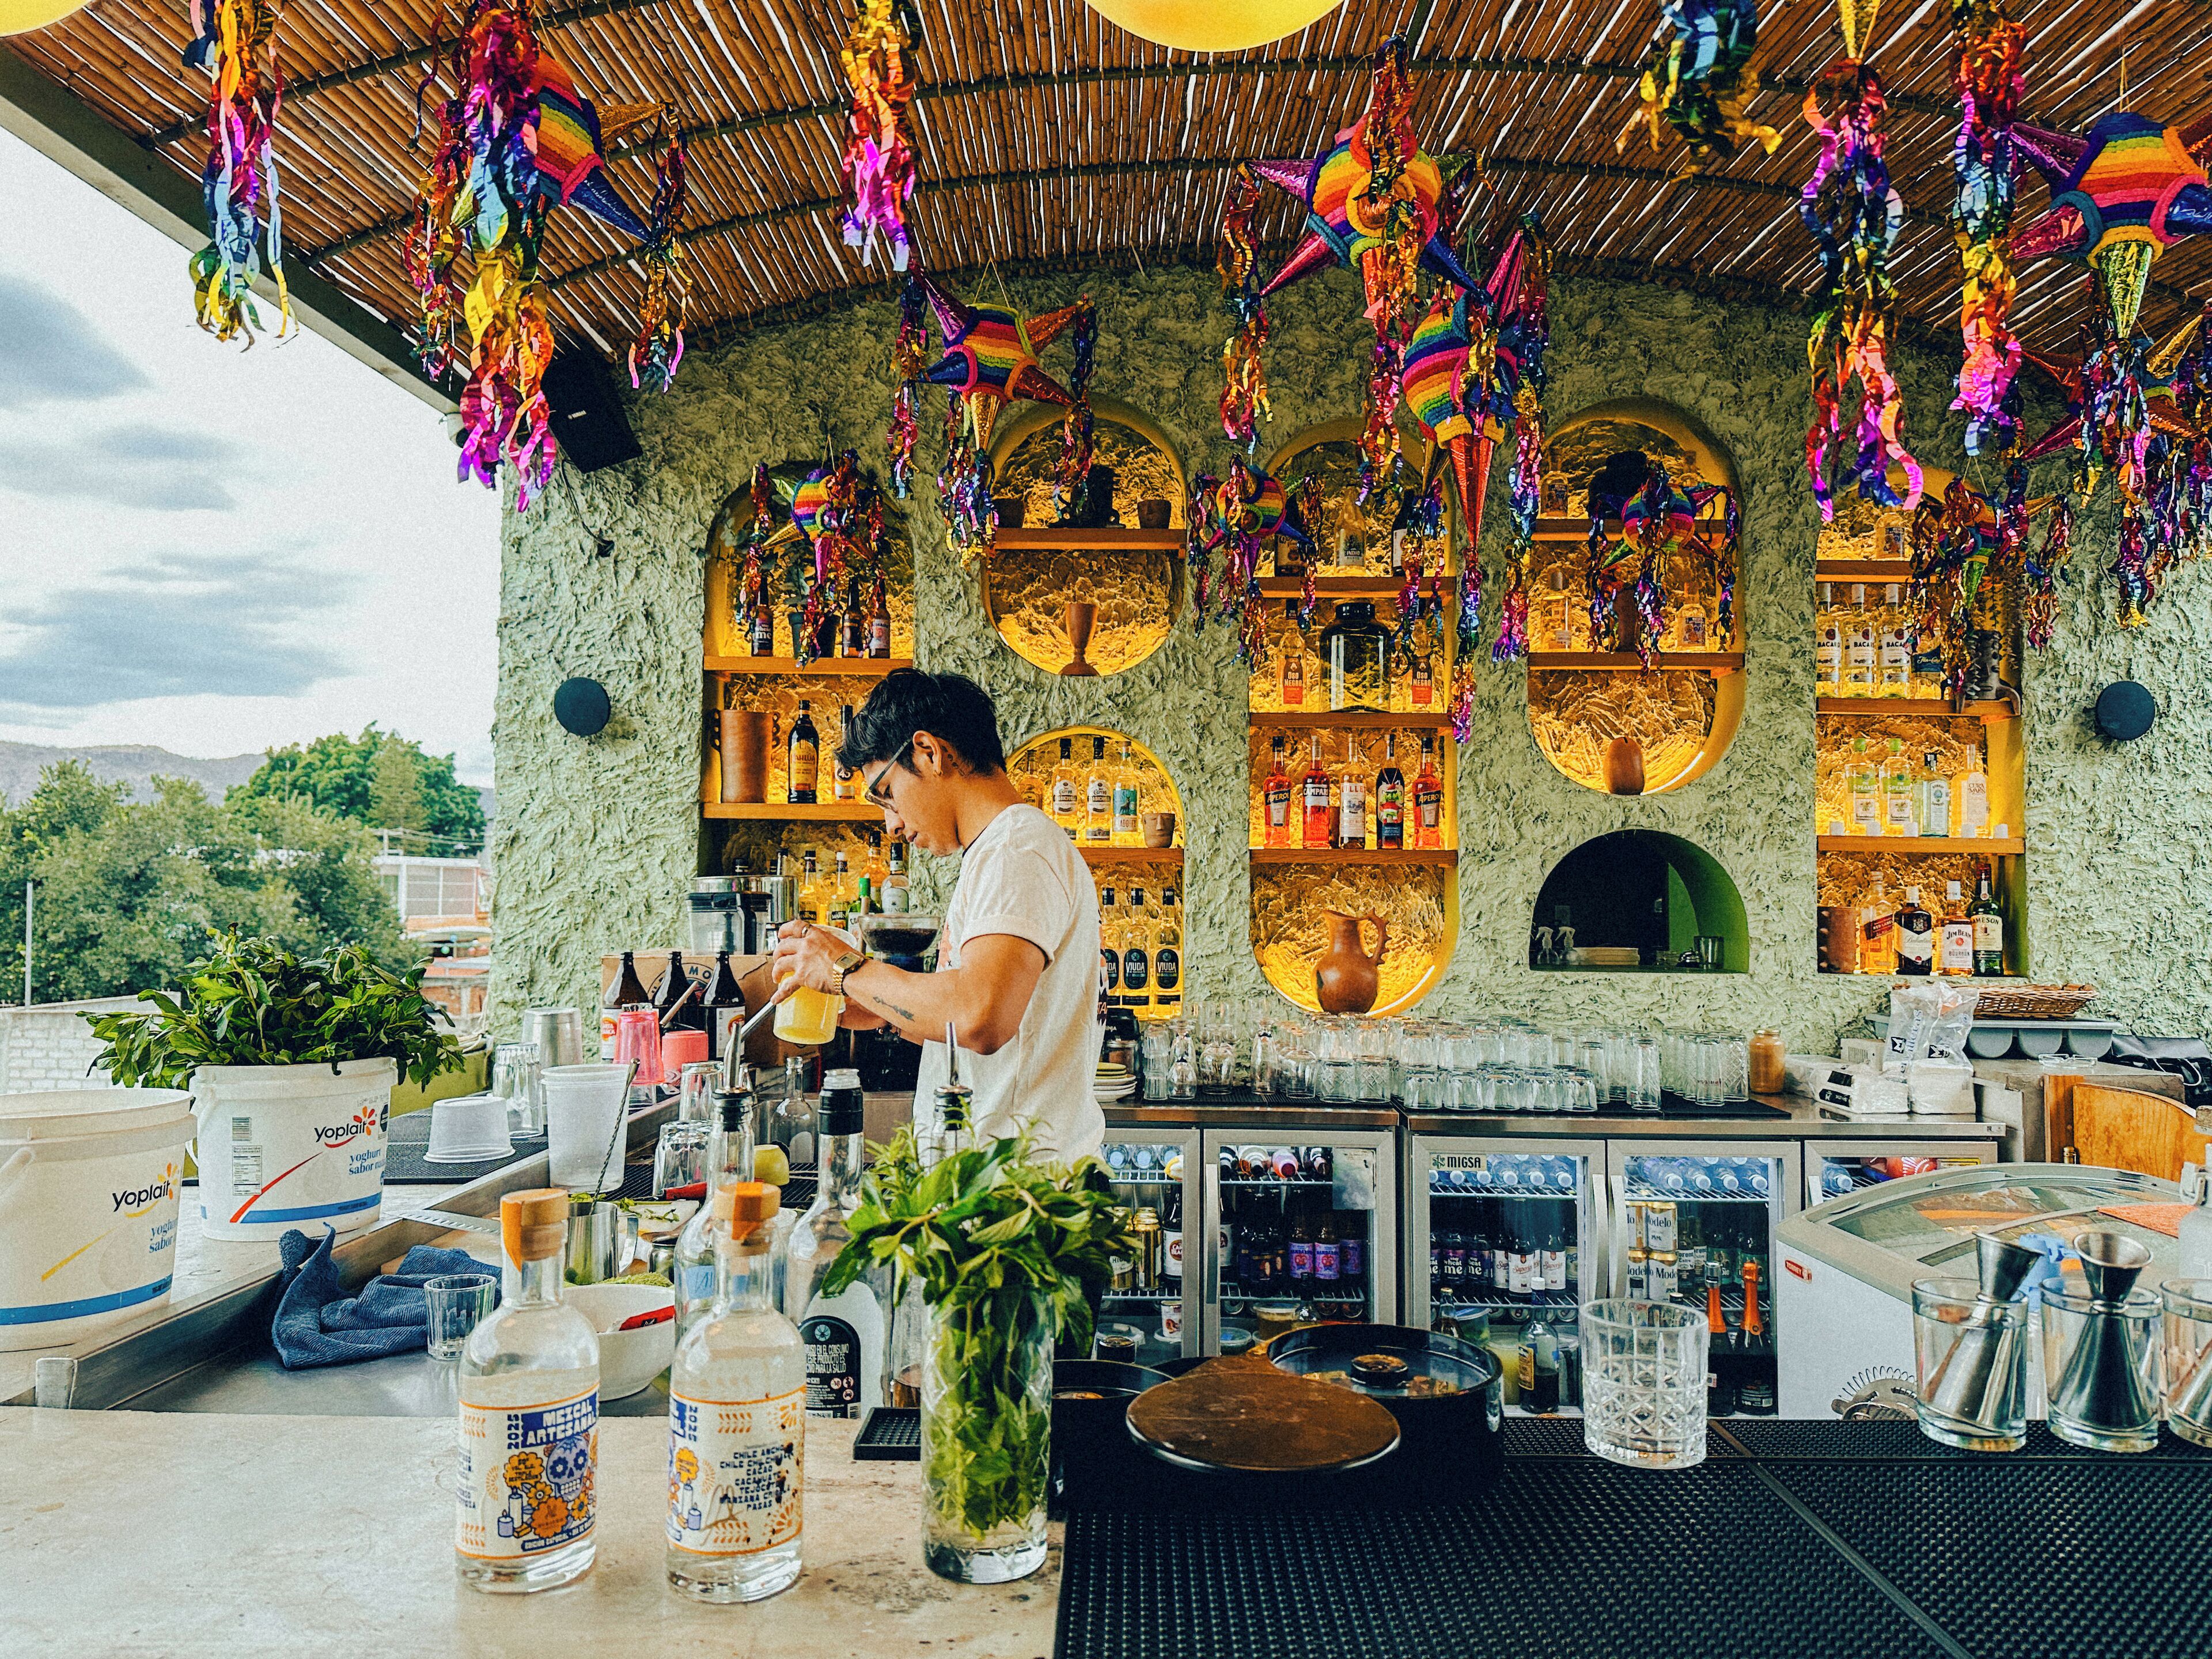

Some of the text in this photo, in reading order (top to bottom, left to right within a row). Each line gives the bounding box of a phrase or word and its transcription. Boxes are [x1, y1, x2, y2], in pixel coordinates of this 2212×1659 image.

[1287, 671, 1299, 679] OSO
[1416, 671, 1427, 679] OSO
[1303, 787, 1328, 796] CAMPARI
[1267, 792, 1289, 804] APEROL
[1946, 931, 1957, 940] JIM
[1107, 962, 1116, 973] UDA
[1126, 962, 1145, 973] VIUDA
[1157, 962, 1176, 973] VIUDA
[1447, 1156, 1481, 1168] MIGSA
[349, 1162, 374, 1176] sabor
[150, 1217, 178, 1241] yogh
[149, 1234, 173, 1253] sabor
[1444, 1265, 1463, 1275] me
[1656, 1267, 1677, 1279] Mode
[543, 1399, 592, 1427] MEZCAL
[527, 1411, 596, 1445] ARTESANAL
[688, 1405, 698, 1442] 2025
[507, 1414, 519, 1449] 2025
[733, 1450, 757, 1459] CHILE
[720, 1460, 744, 1468] CHILE
[746, 1465, 772, 1476] CACAO
[747, 1499, 772, 1512] PASAS
